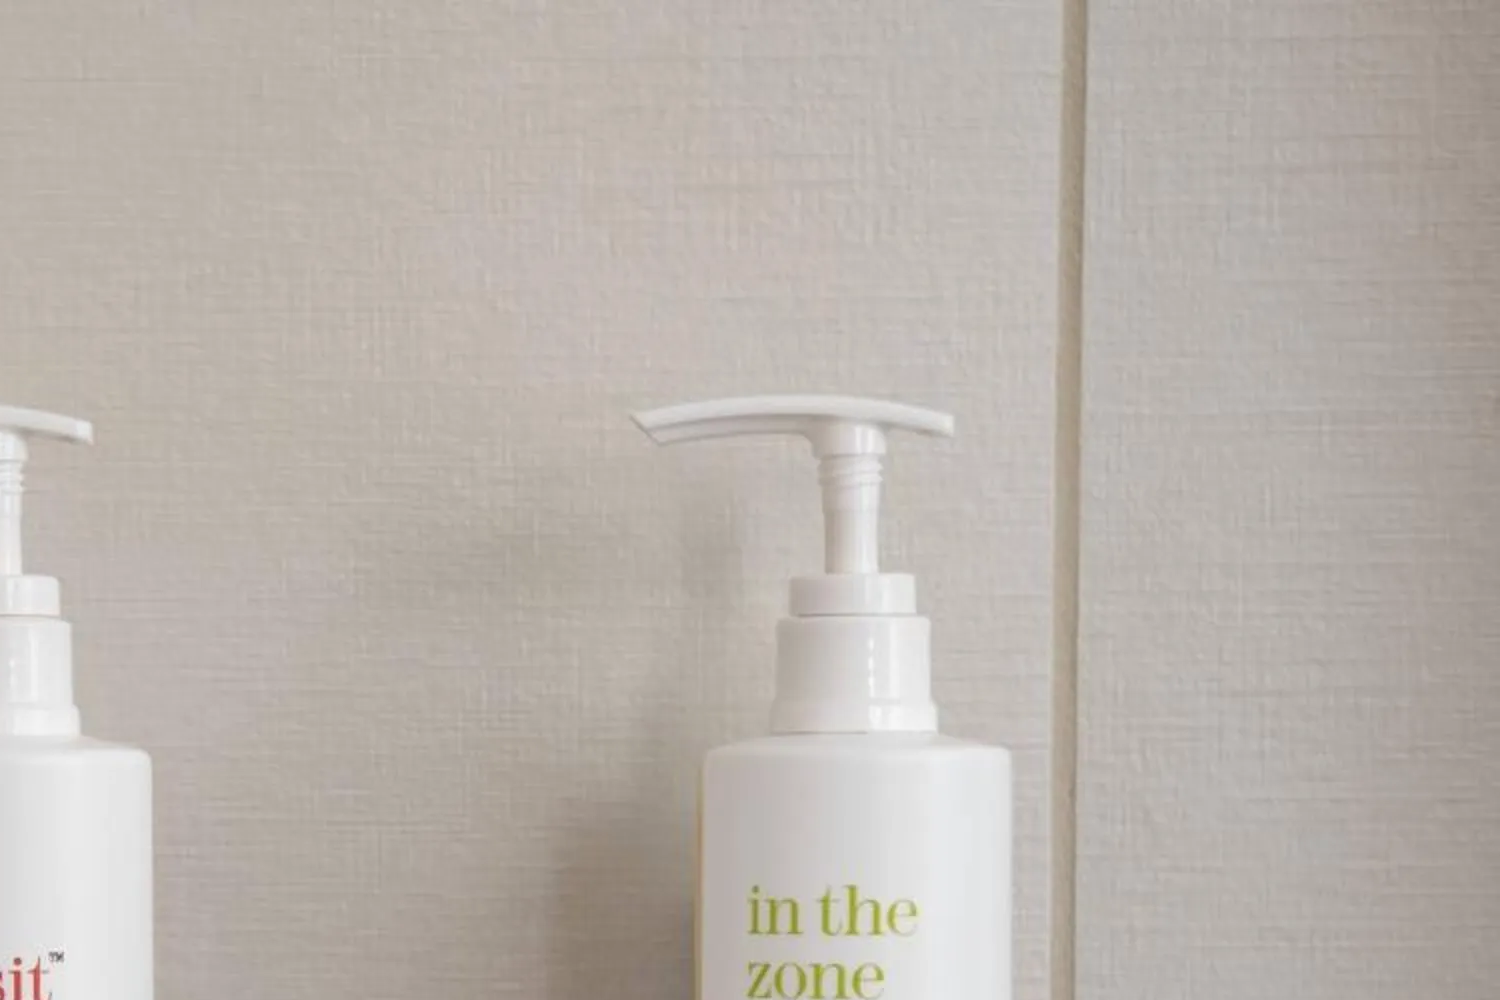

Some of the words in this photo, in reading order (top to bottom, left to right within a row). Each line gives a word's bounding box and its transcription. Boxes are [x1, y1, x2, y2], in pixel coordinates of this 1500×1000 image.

[747, 885, 803, 936] in
[817, 883, 918, 936] the
[746, 959, 885, 1000] zone
